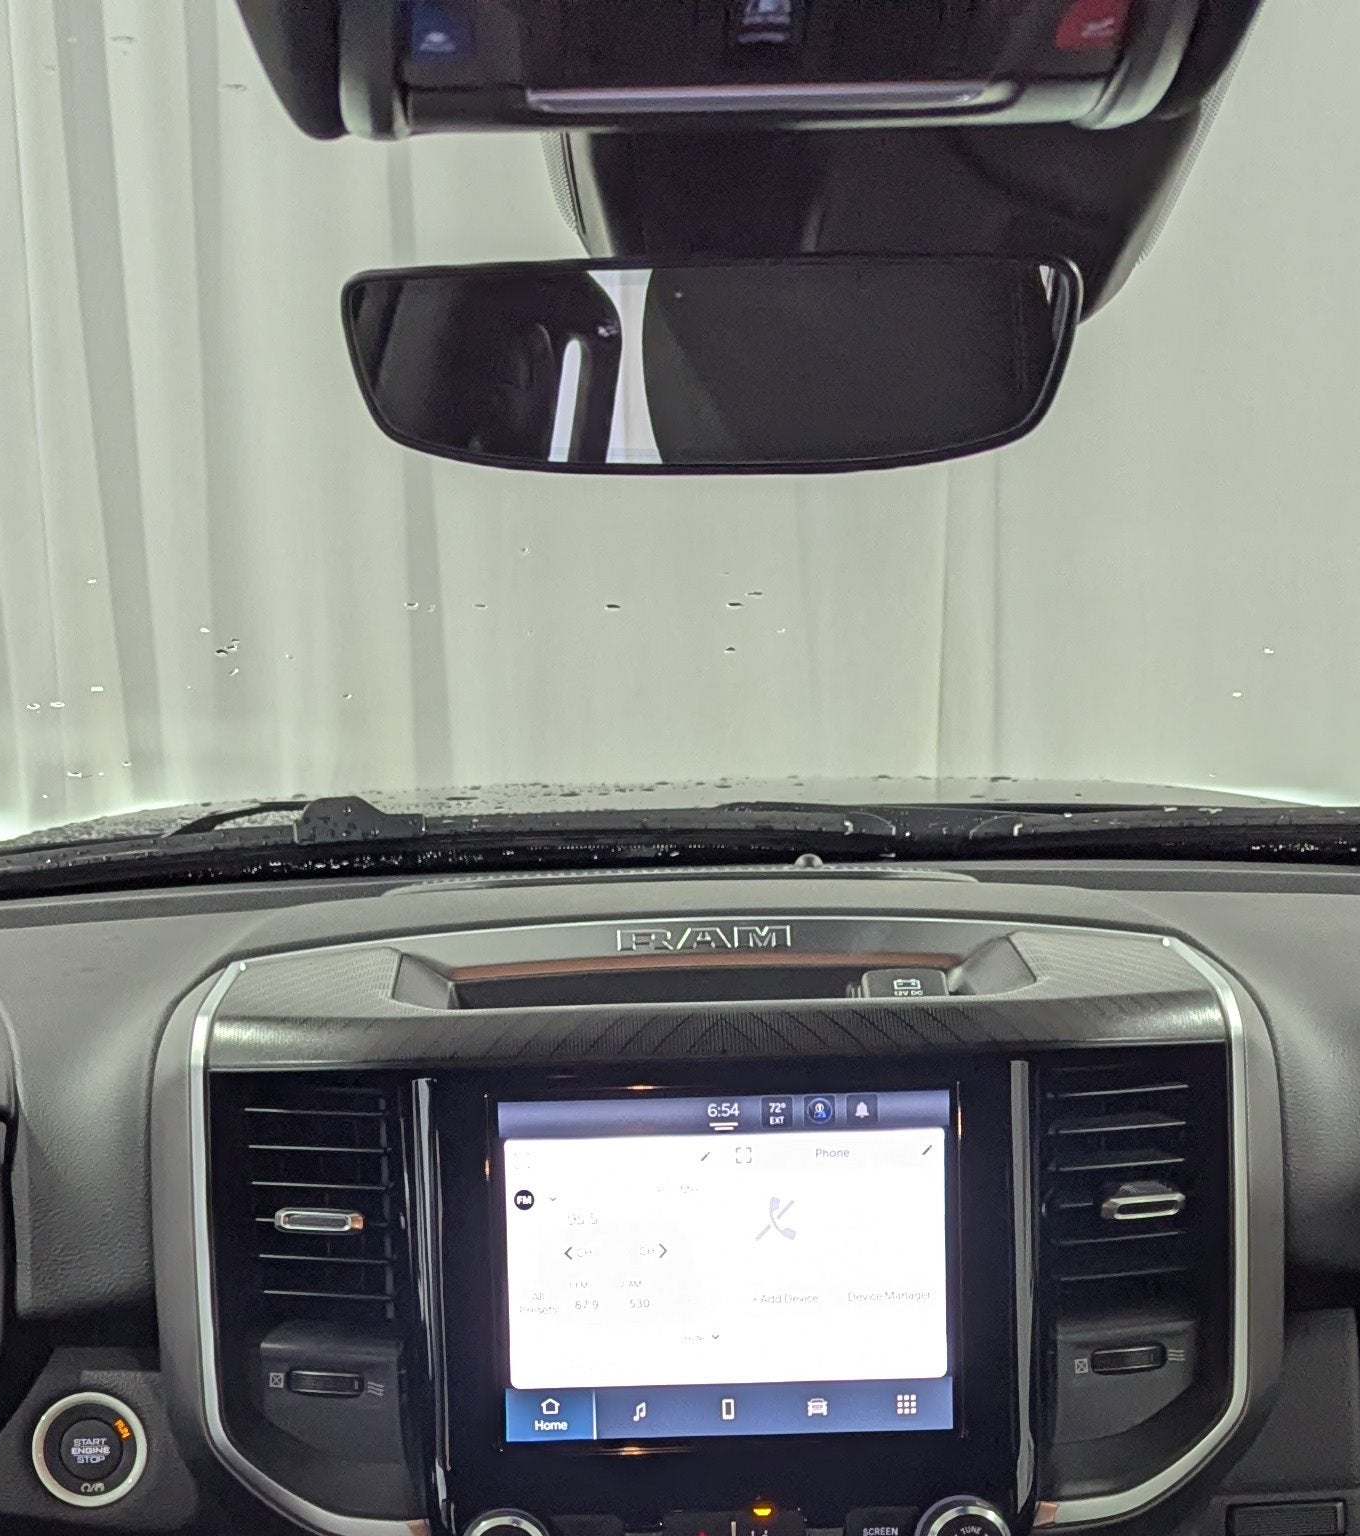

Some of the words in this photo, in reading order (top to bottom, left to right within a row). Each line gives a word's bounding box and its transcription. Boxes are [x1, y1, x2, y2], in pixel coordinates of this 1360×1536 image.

[617, 925, 791, 951] RAM
[707, 1102, 740, 1117] 6:54
[770, 1116, 785, 1125] EXT
[815, 1147, 850, 1158] Phone
[629, 1298, 650, 1309] 530
[534, 1419, 568, 1431] Home
[73, 1438, 107, 1446] START
[71, 1446, 111, 1455] ENGINE
[77, 1455, 106, 1464] STOP
[862, 1527, 899, 1536] SCREEN
[960, 1526, 982, 1536] TUNE
